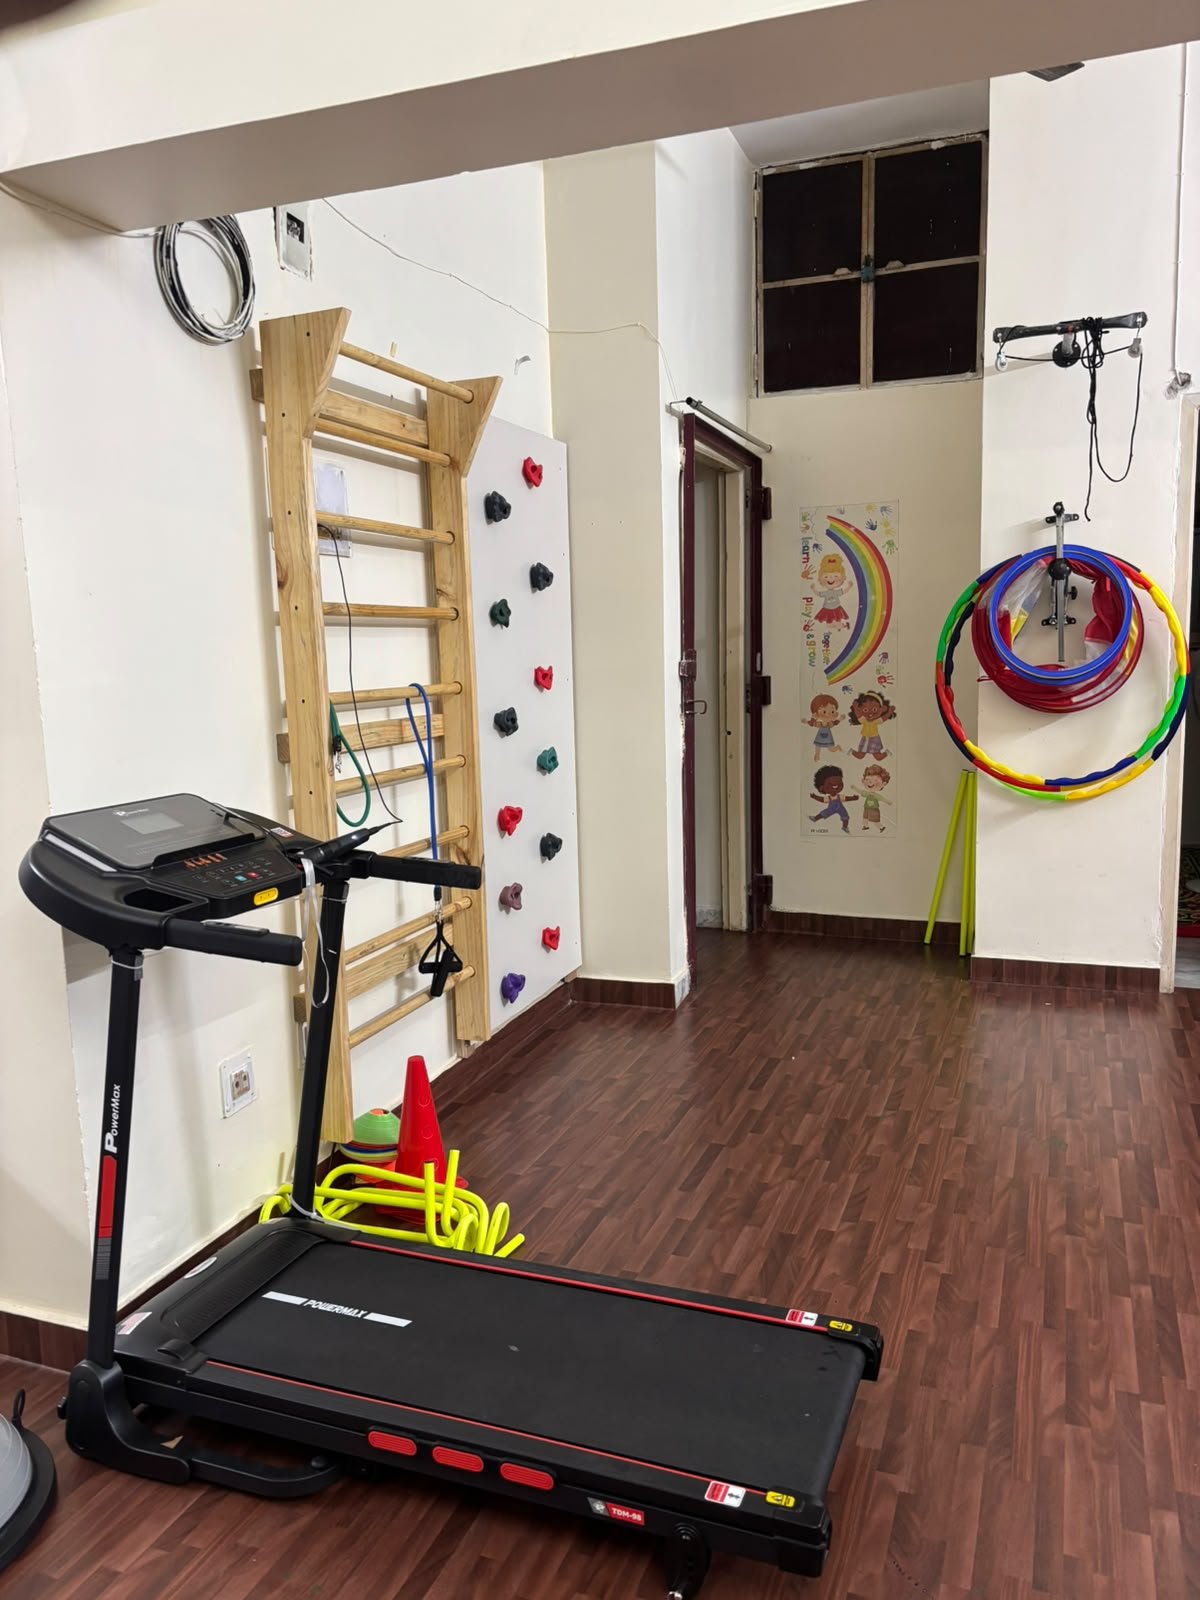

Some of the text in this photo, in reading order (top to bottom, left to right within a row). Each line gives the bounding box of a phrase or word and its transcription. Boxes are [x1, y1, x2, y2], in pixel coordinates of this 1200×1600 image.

[801, 537, 812, 563] learn
[801, 597, 814, 618] play
[806, 640, 817, 667] grow
[104, 1084, 121, 1153] PowerMax
[304, 1299, 368, 1318] POWERMAX
